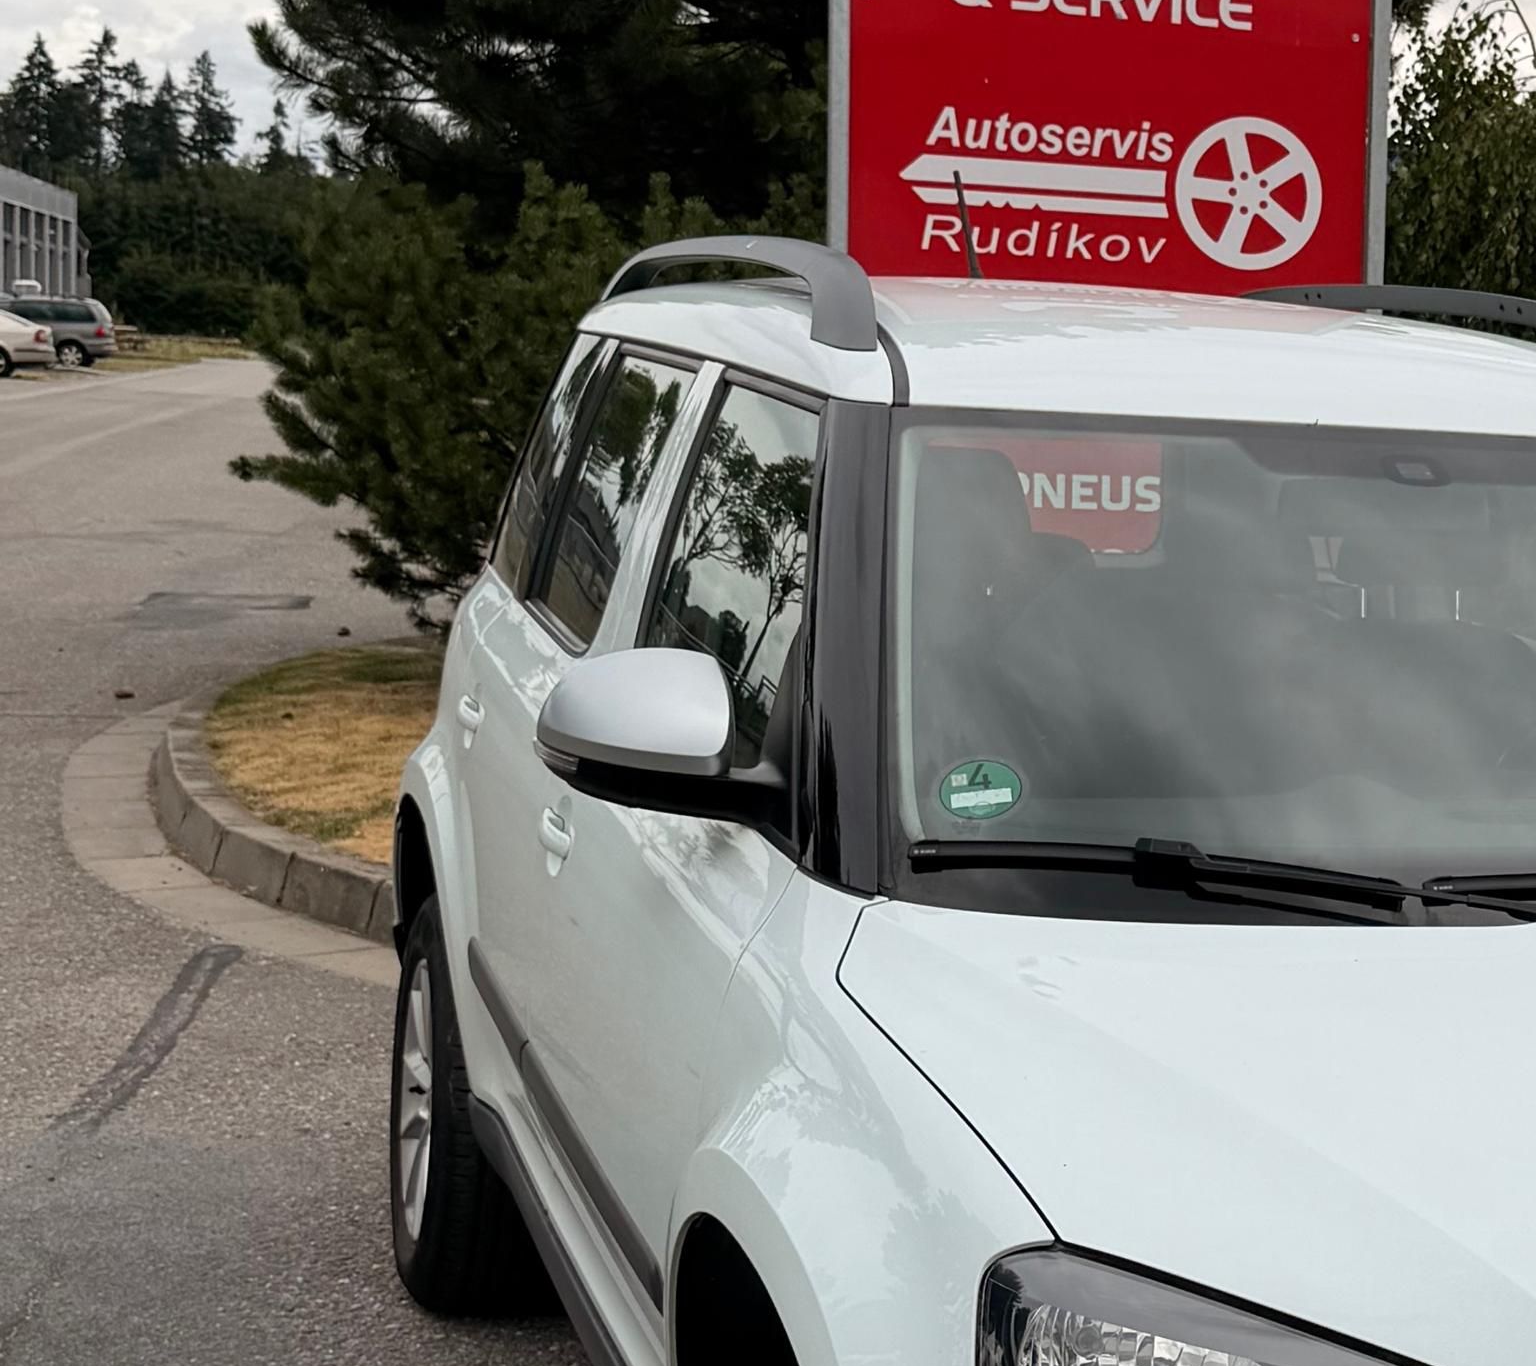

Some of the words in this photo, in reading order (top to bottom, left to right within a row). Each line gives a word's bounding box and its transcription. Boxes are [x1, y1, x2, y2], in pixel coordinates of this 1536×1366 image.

[925, 105, 1175, 163] Autoservis
[920, 213, 1167, 264] Rudíkov
[1018, 471, 1161, 512] NEUS
[968, 763, 992, 790] 4
